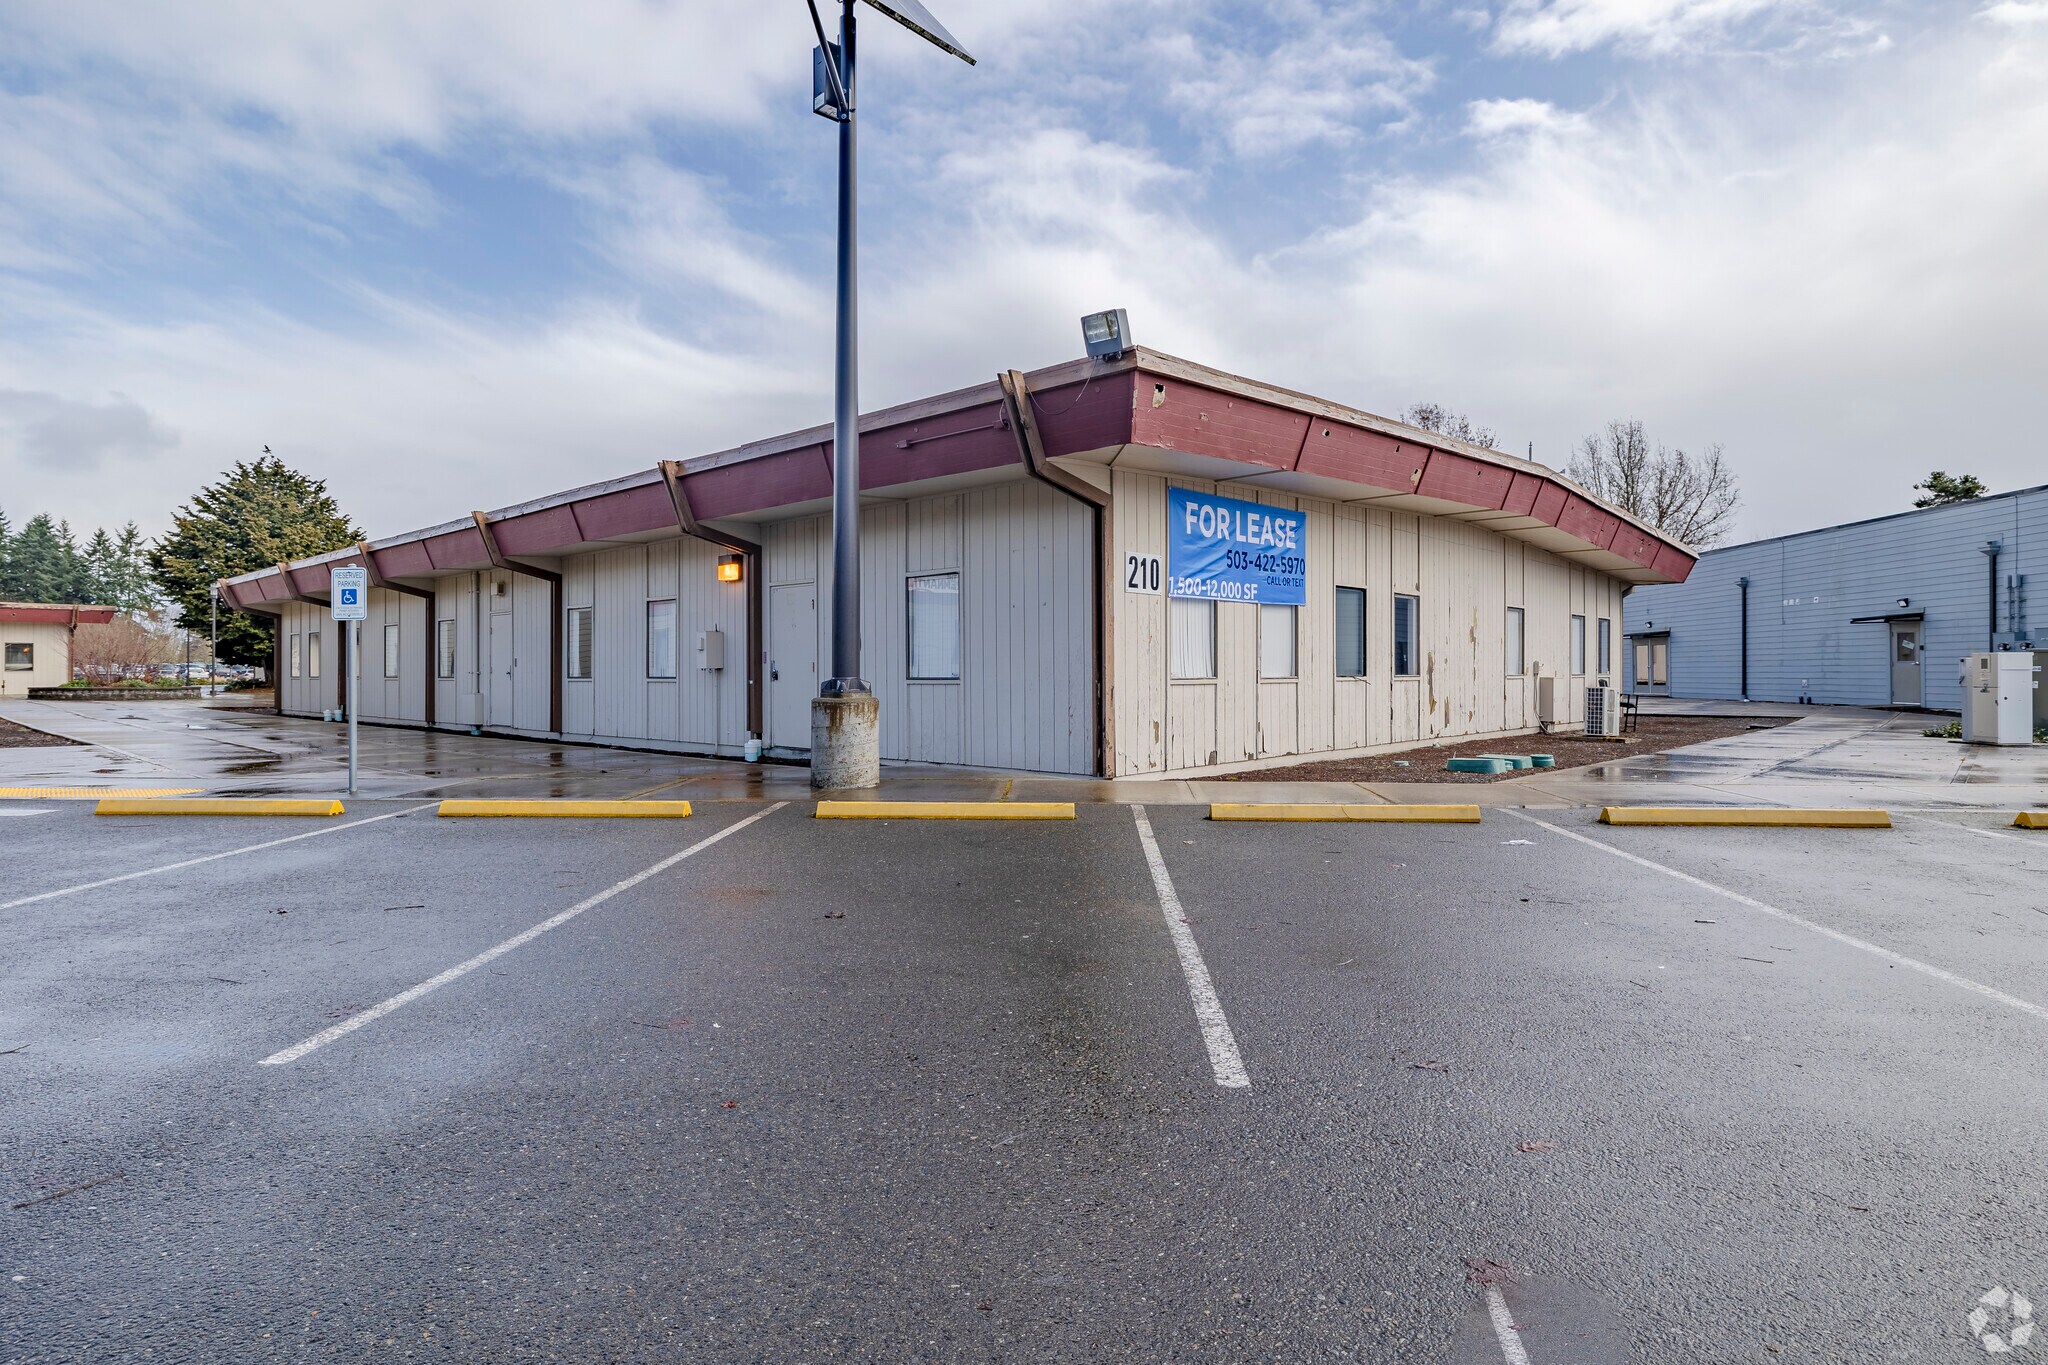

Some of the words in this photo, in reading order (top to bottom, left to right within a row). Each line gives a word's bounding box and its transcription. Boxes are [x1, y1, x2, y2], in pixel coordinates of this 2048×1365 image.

[1185, 501, 1230, 541] FOR
[1236, 511, 1297, 549] LEASE
[1128, 555, 1160, 591] 210
[1226, 550, 1306, 576] 503-422-5970
[338, 580, 361, 588] PARKING
[1168, 576, 1242, 599] 1,500-12,000
[1243, 583, 1258, 600] SF
[1266, 575, 1281, 586] CALL
[1282, 577, 1291, 587] OR
[1292, 578, 1304, 588] TEXT
